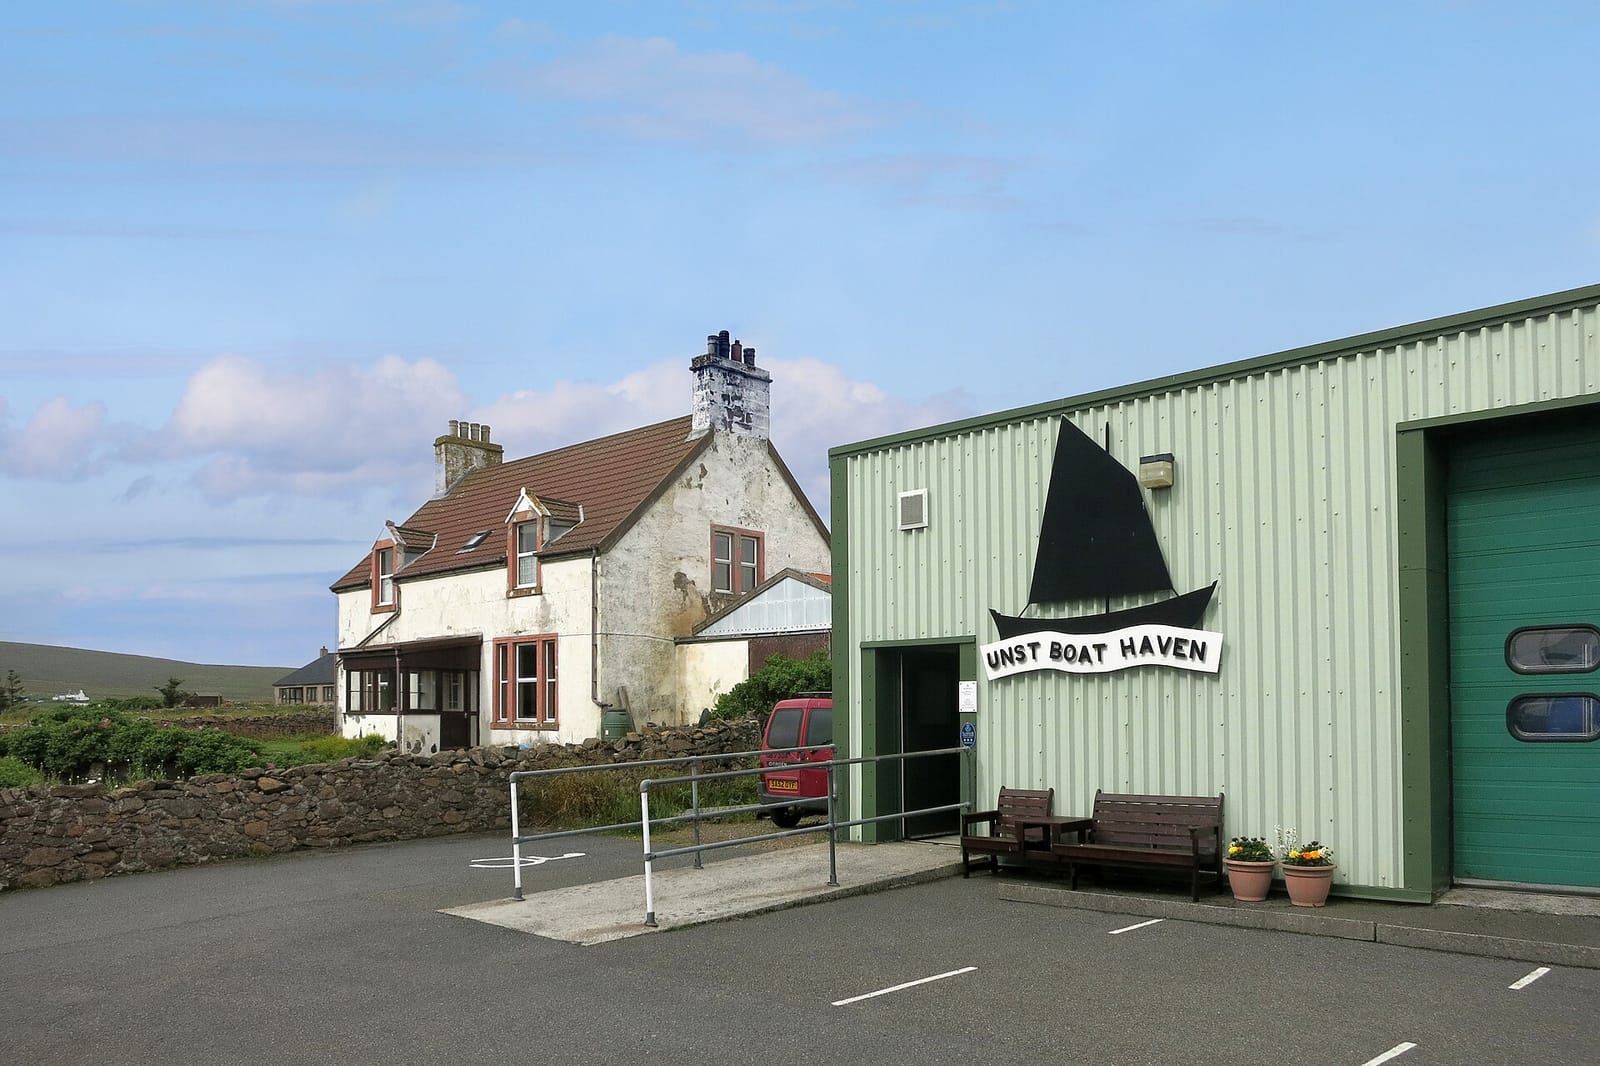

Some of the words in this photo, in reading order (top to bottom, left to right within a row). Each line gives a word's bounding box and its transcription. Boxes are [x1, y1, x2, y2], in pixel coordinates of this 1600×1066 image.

[987, 641, 1041, 669] UNST
[1049, 641, 1107, 665] BOAT
[1119, 635, 1207, 661] HAVEN
